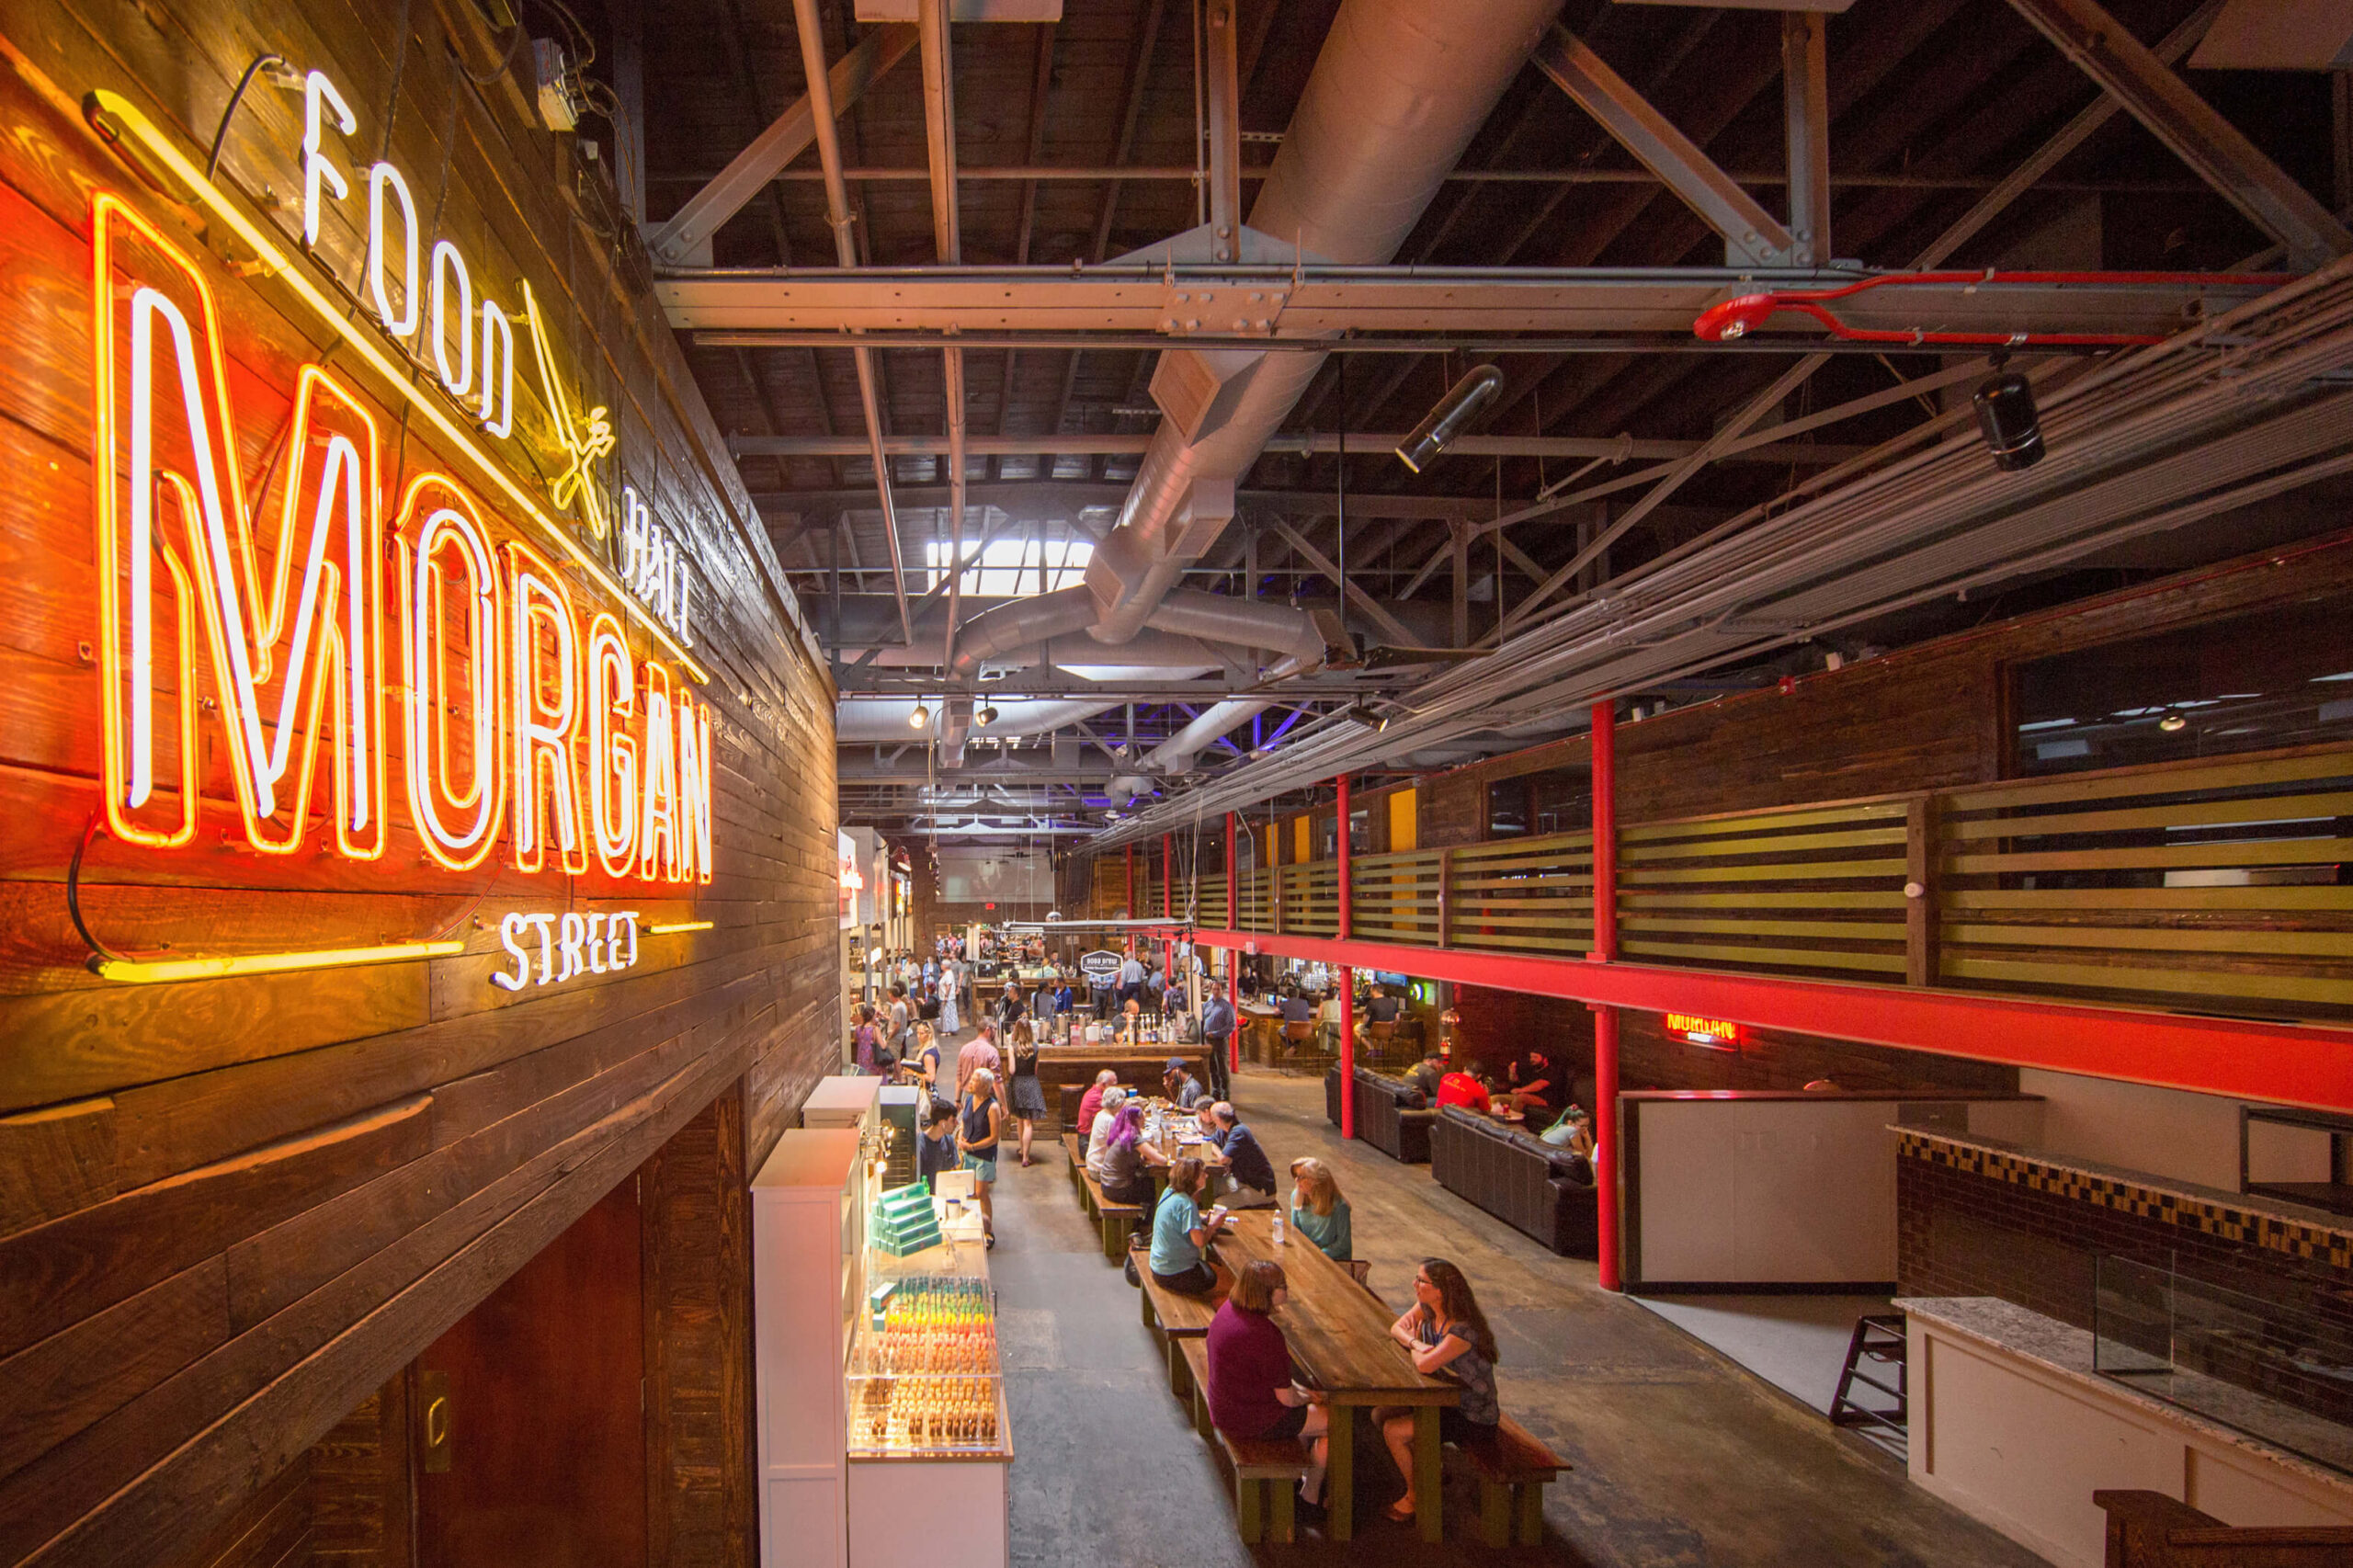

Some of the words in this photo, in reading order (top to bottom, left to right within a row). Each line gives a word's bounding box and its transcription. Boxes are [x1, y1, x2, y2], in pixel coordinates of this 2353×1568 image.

[303, 70, 514, 439] FOOD
[620, 485, 694, 649] HALL
[95, 189, 712, 885] MORGAN
[492, 911, 640, 992] STREET
[1666, 1013, 1736, 1040] MORGAN
